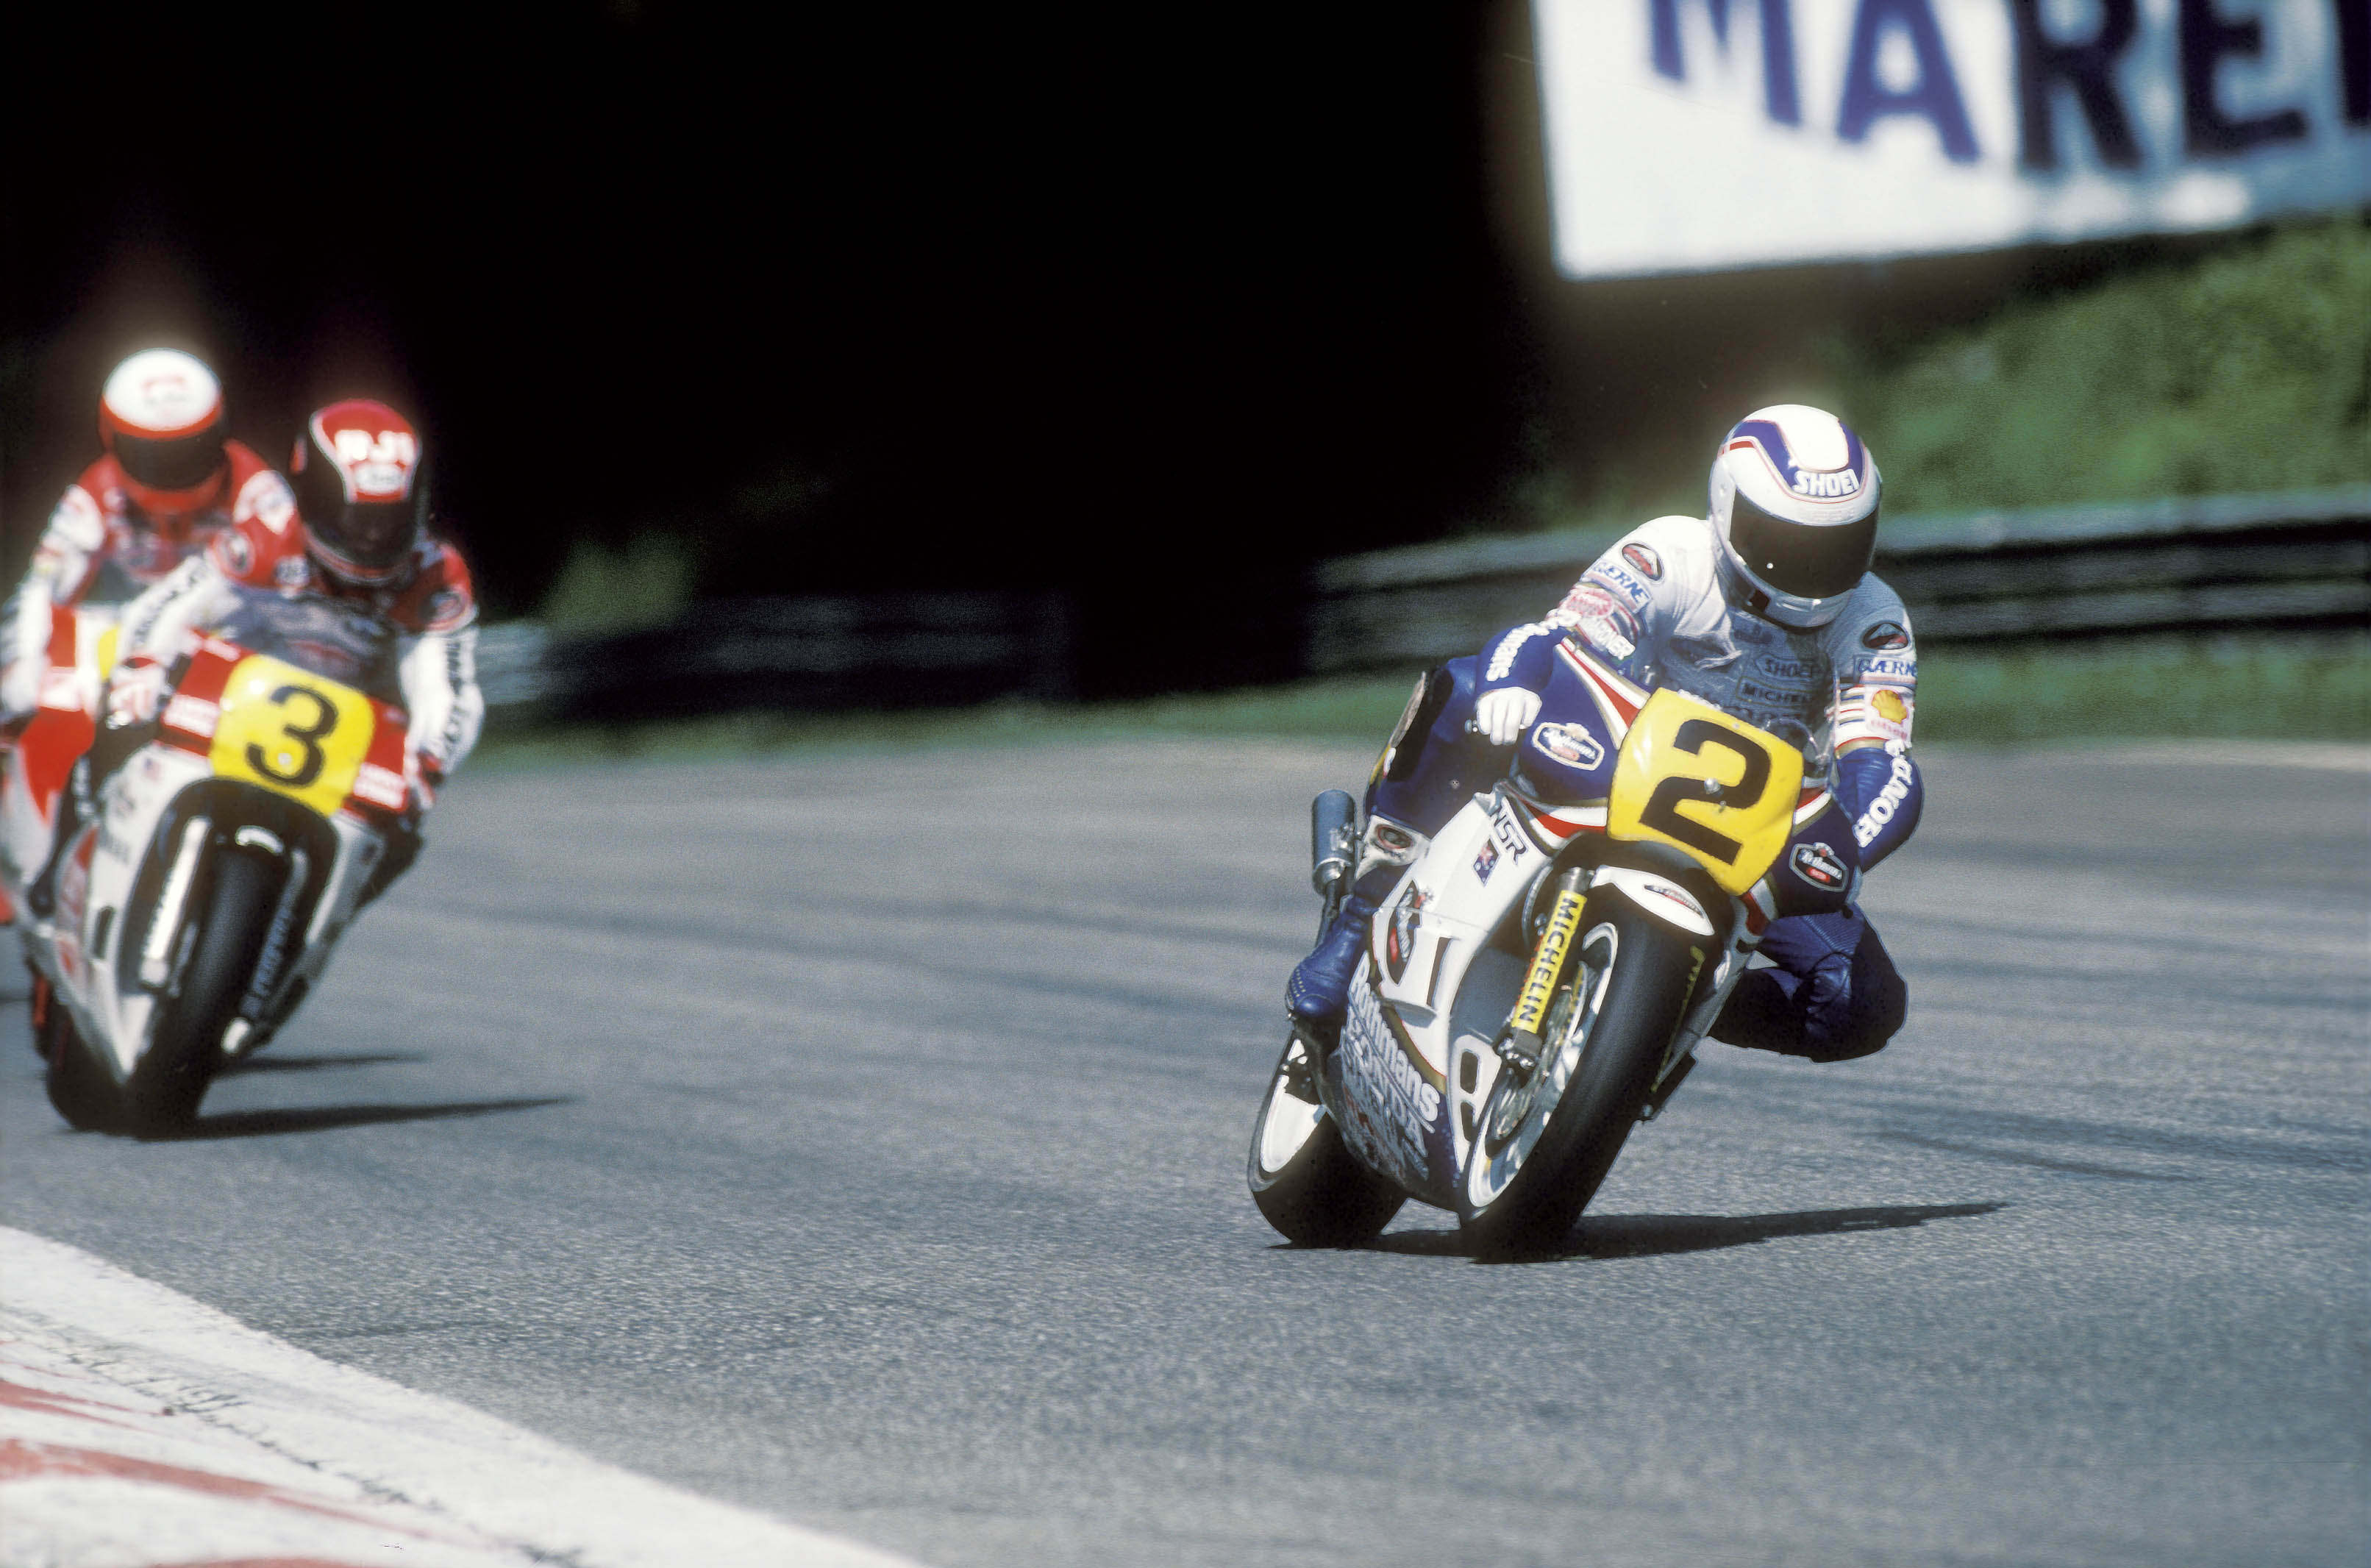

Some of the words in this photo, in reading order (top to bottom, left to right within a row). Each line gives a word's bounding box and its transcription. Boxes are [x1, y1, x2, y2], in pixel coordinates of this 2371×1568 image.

[1792, 468, 1860, 496] SHOEI
[245, 684, 339, 788] 3
[1489, 805, 1527, 863] NSR
[1639, 719, 1772, 866] 2
[1853, 738, 1913, 848] HONDA
[1518, 897, 1579, 1023] MICHELIN
[1349, 949, 1441, 1122] Rothmans
